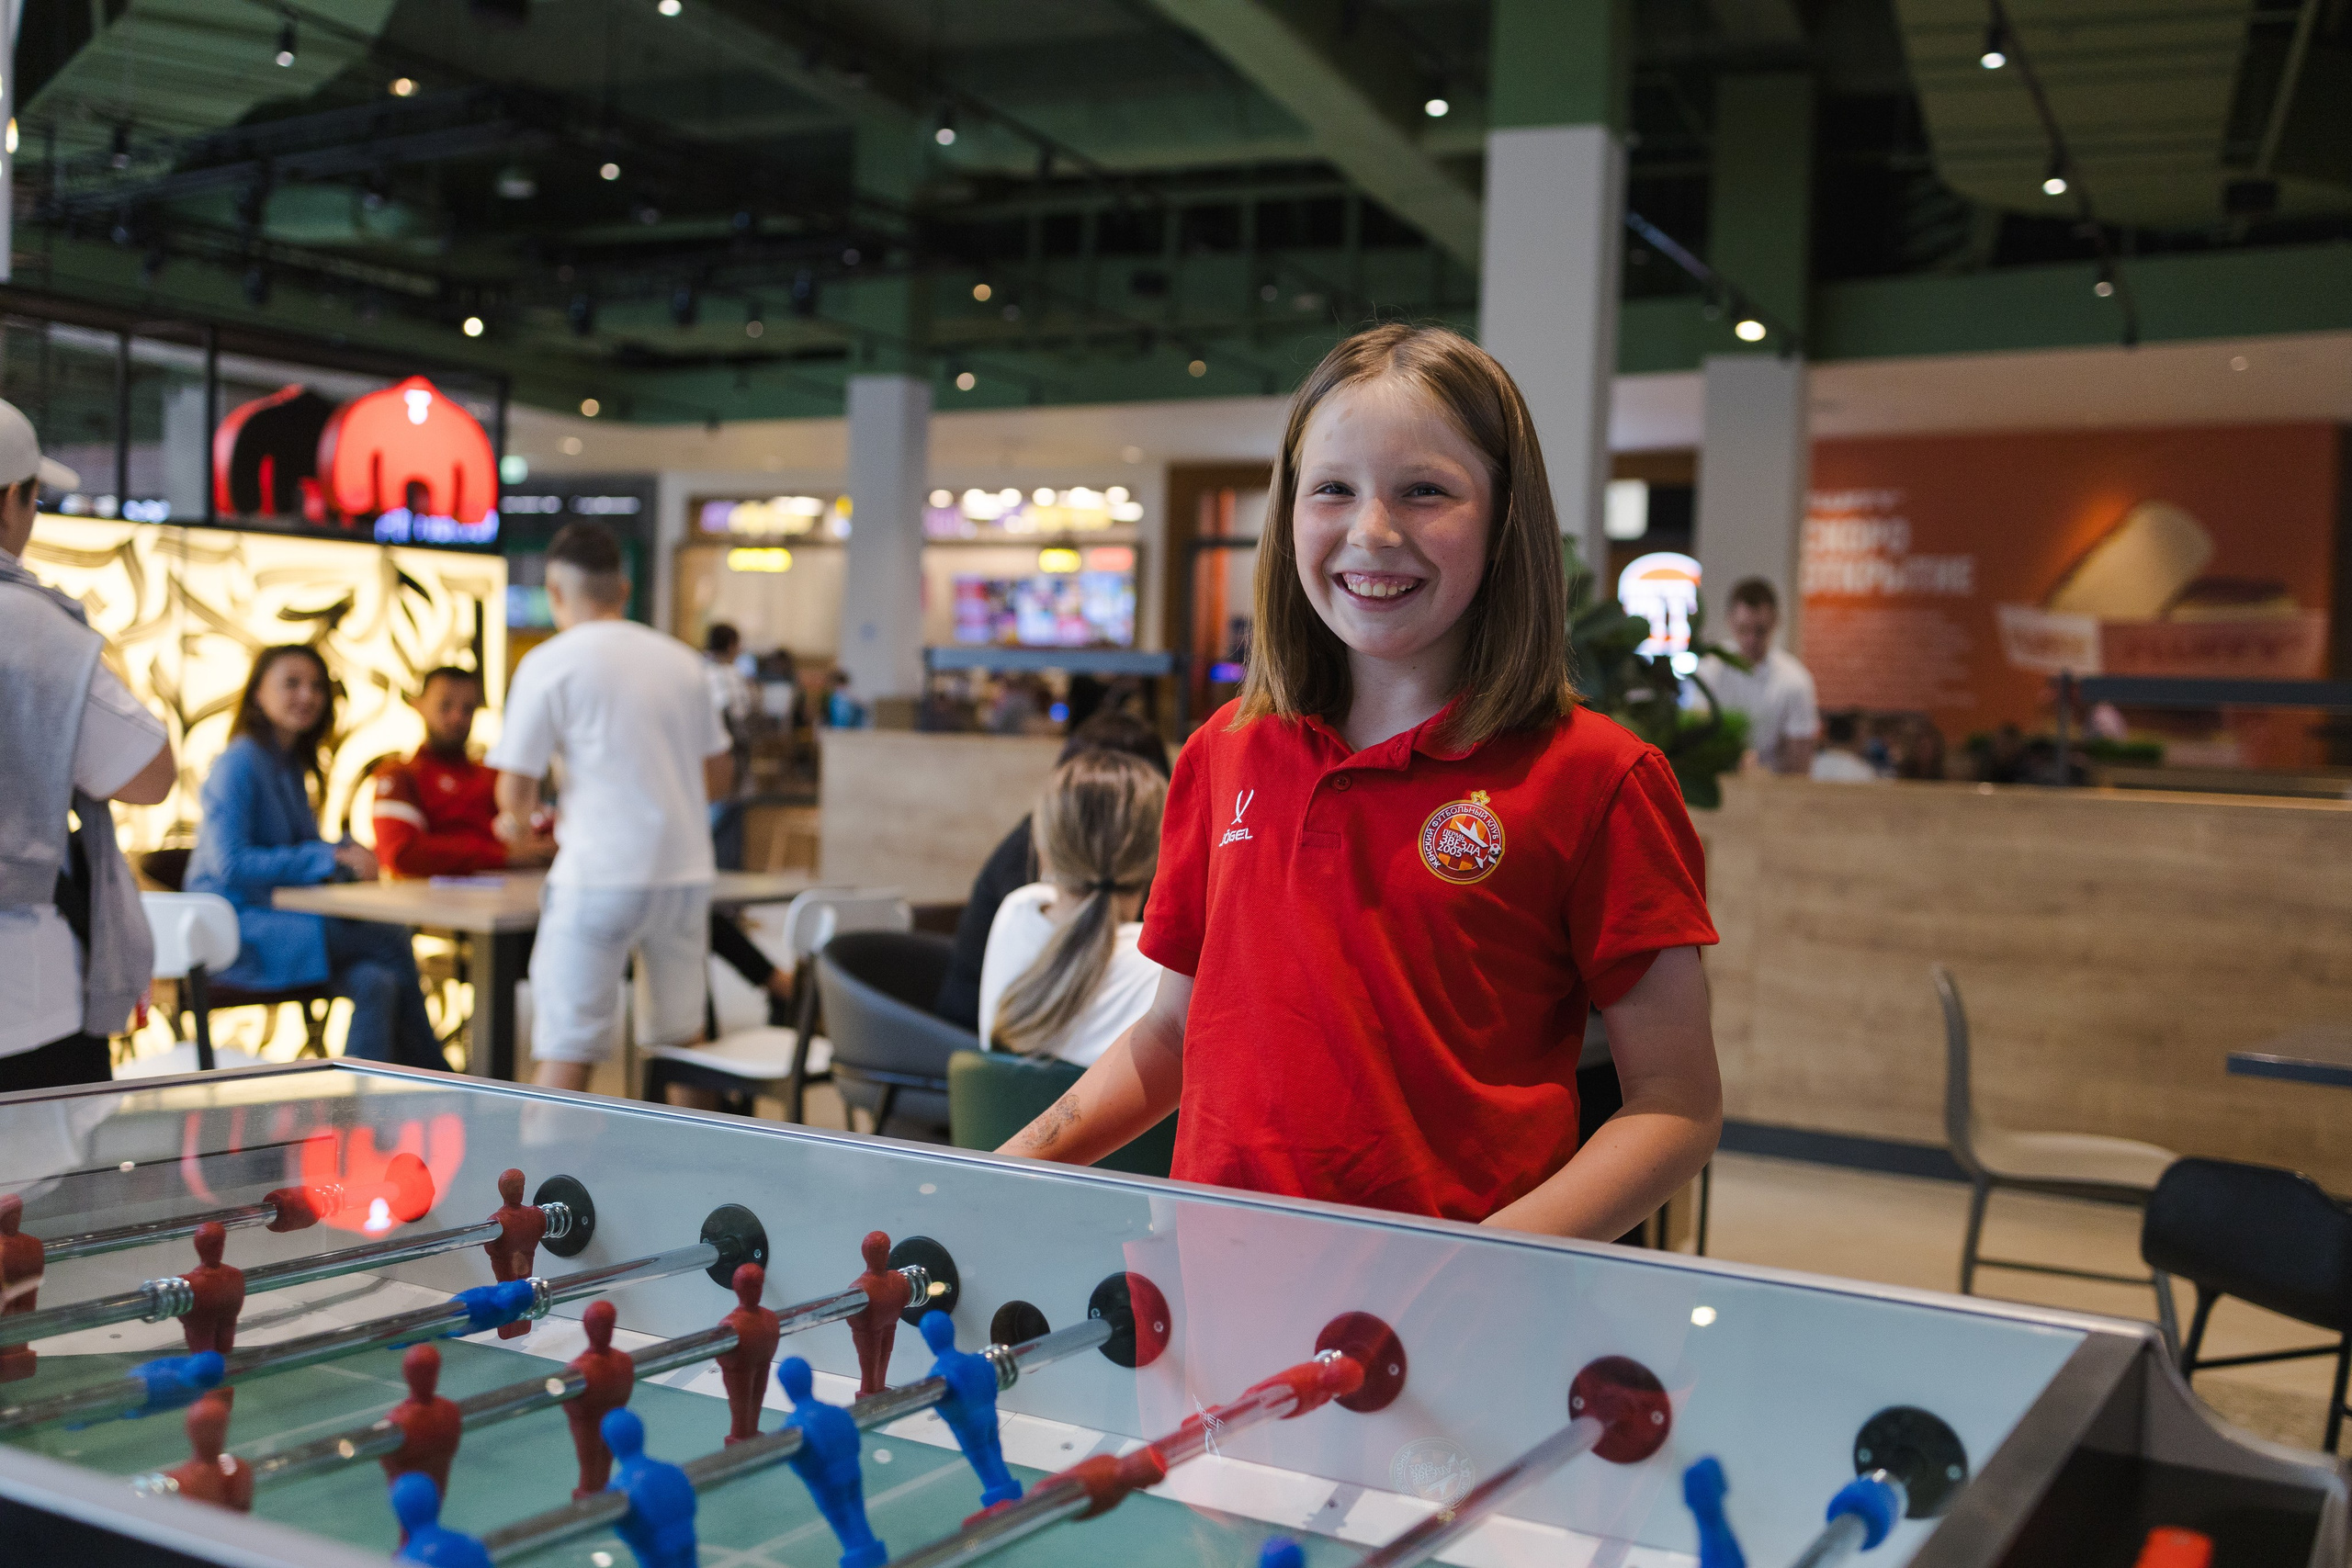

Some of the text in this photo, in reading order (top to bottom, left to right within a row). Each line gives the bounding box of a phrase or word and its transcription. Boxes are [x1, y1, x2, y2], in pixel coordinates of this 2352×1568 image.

[1423, 806, 1499, 869] ЖЕНСКИЙ ФУТБОЛЬНЫЙ КЛУБ
[1442, 829, 1465, 841] ПЕРМЬ
[1437, 842, 1464, 858] 2005
[1440, 834, 1481, 857] ЗВЕЗДА
